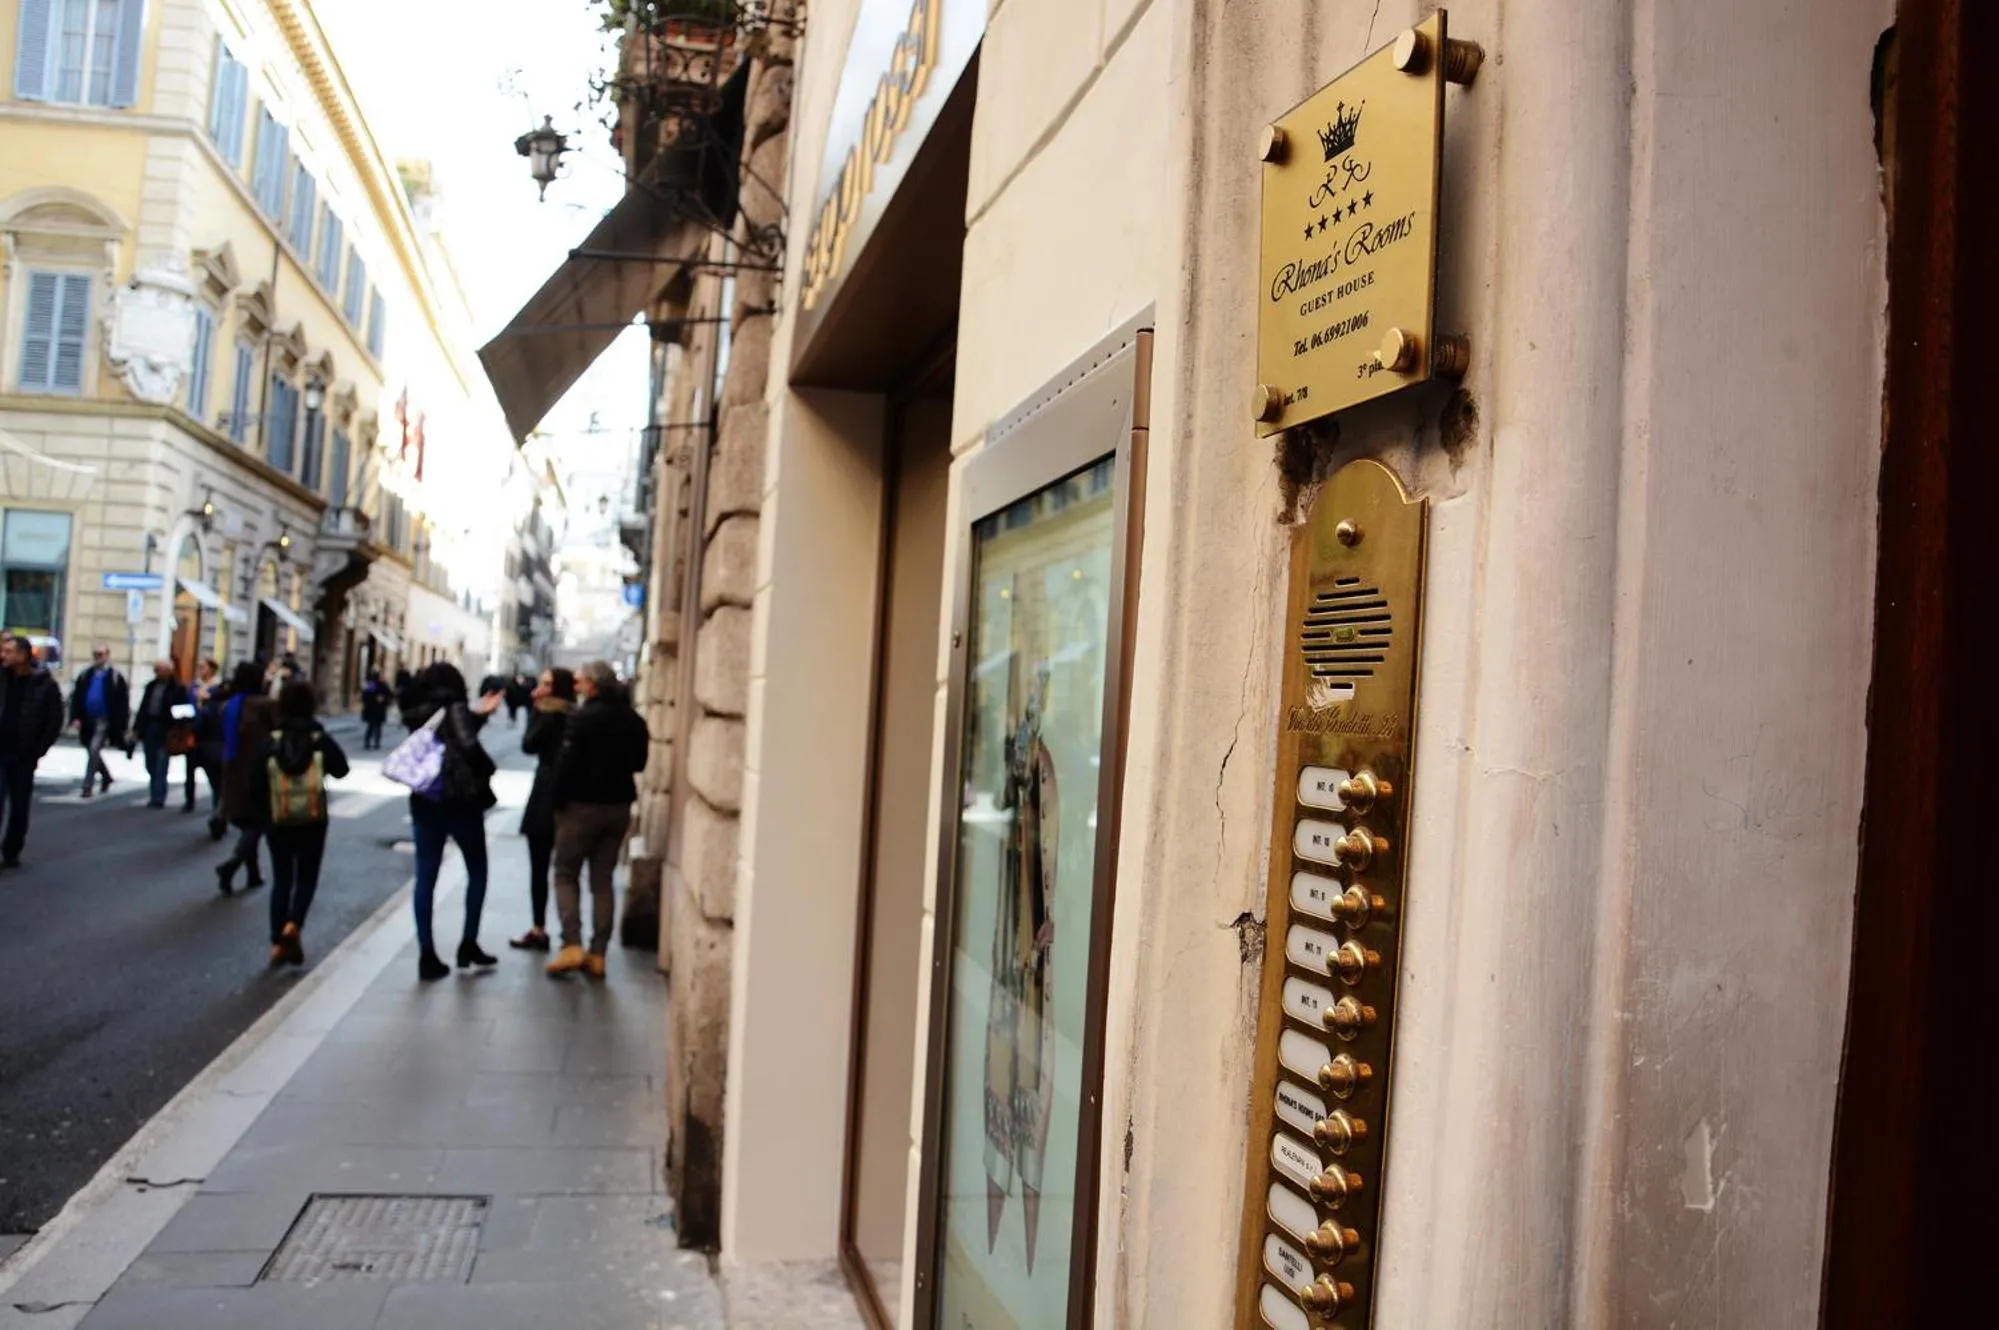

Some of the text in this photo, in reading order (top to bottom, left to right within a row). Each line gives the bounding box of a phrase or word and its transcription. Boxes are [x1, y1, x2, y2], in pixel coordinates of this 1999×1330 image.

[1271, 211, 1416, 301] Rhona's Rooms
[1300, 271, 1375, 316] GUEST HOUSE
[1293, 340, 1308, 357] Tel.
